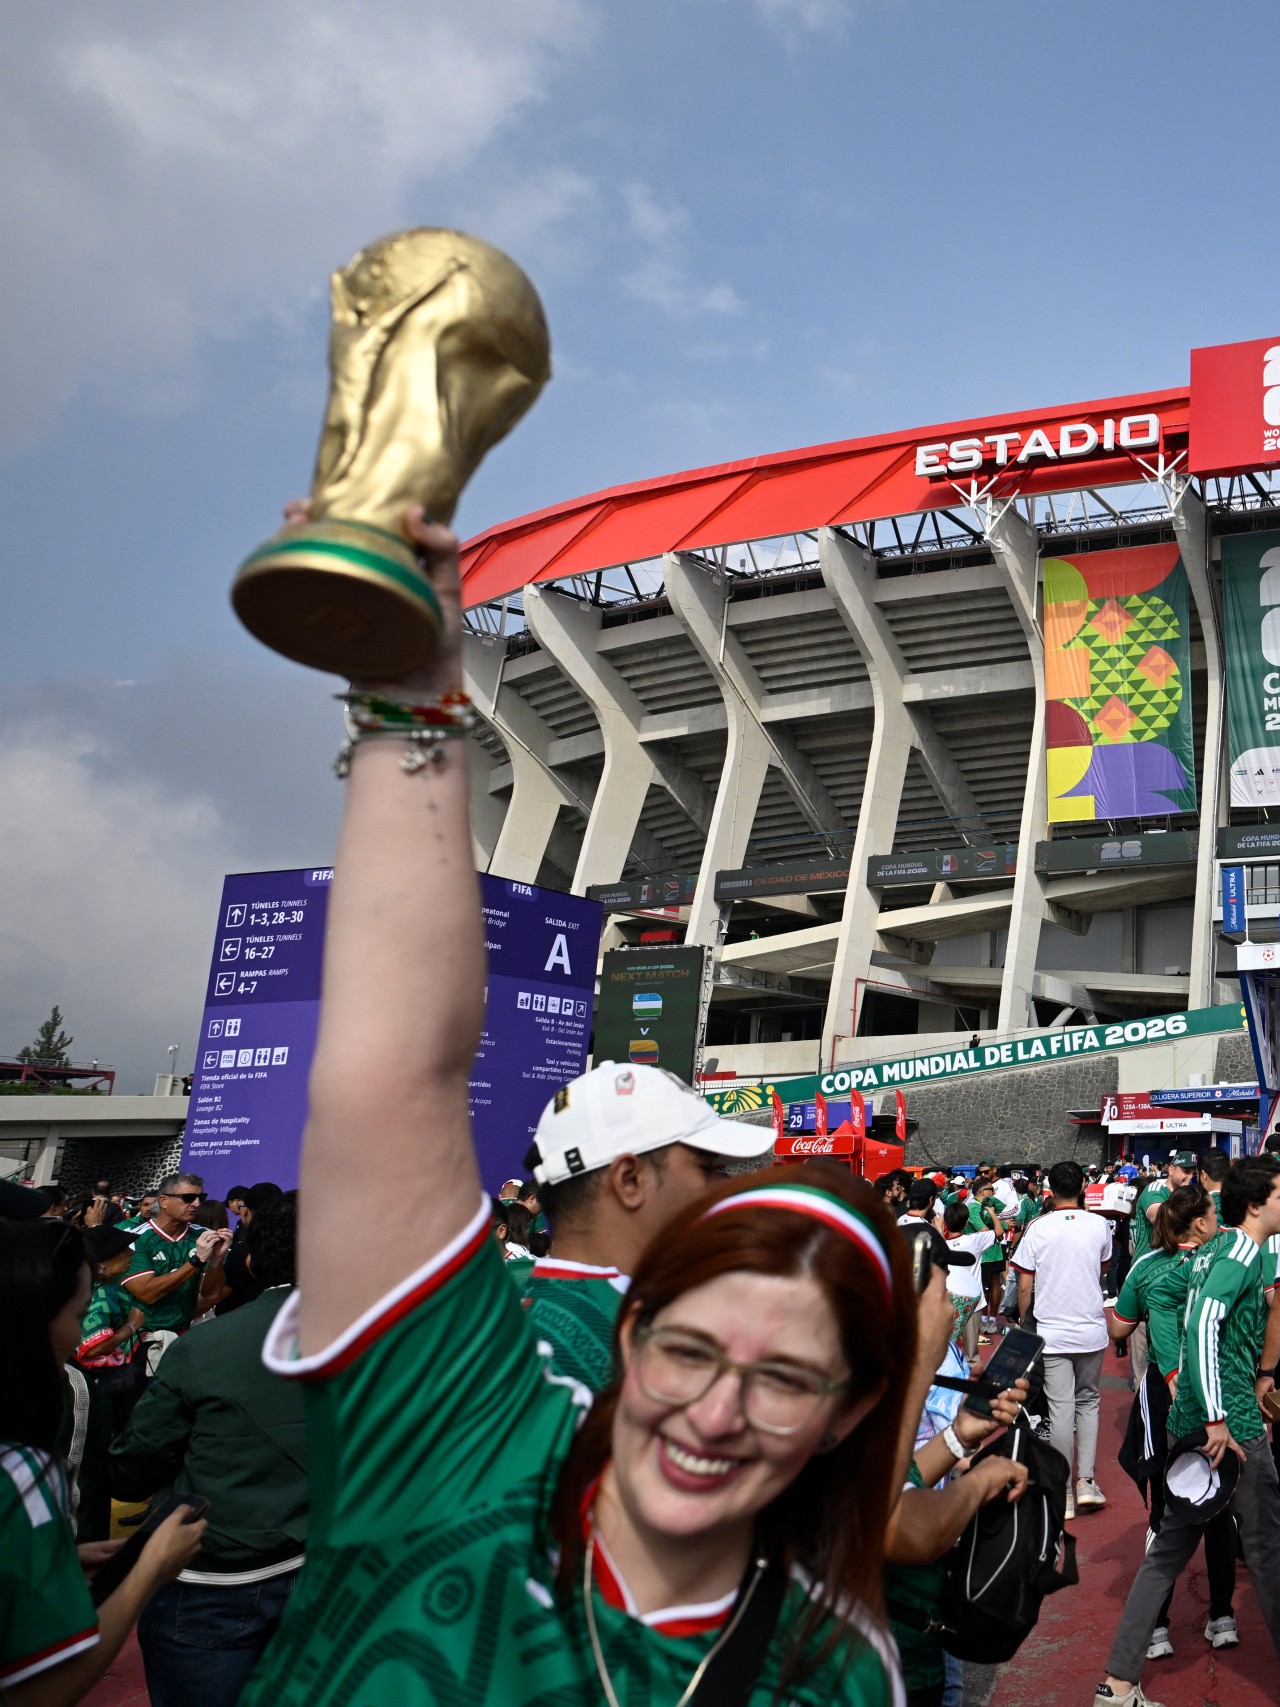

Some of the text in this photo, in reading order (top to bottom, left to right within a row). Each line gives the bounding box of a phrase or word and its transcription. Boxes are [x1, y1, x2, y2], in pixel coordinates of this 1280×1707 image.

[915, 413, 1160, 477] ESTADIO
[898, 861, 924, 869] MUNDIAL
[312, 870, 334, 881] FIFA
[754, 870, 850, 886] CIUDAD DE MÉXICO
[512, 883, 532, 896] FIFA
[251, 899, 307, 910] TÚNELES TUNNELS
[482, 907, 510, 918] peatonal
[487, 918, 507, 928] Bridge
[545, 917, 580, 931] SALIDA EXIT
[246, 933, 303, 944] TÚNELES TUNNELS
[544, 933, 572, 975] A
[240, 968, 289, 978] RAMPAS RAMPS
[611, 969, 690, 981] NEXT MATCH
[535, 1016, 550, 1024] Salida
[821, 1014, 1187, 1094] COPA MUNDIAL DE LA FIFA 2026
[221, 1073, 238, 1081] oficial
[211, 1082, 225, 1090] Store
[1180, 1091, 1212, 1099] SUPERIOR
[1225, 1088, 1255, 1098] Michelob
[197, 1096, 213, 1104] Salón
[196, 1105, 215, 1113] Lounge
[220, 1116, 250, 1125] hospitality
[790, 1114, 803, 1128] 29
[193, 1126, 237, 1135] Hospitality Village
[209, 1140, 223, 1148] para
[224, 1138, 260, 1147] trabajadores
[189, 1149, 213, 1157] Workforce
